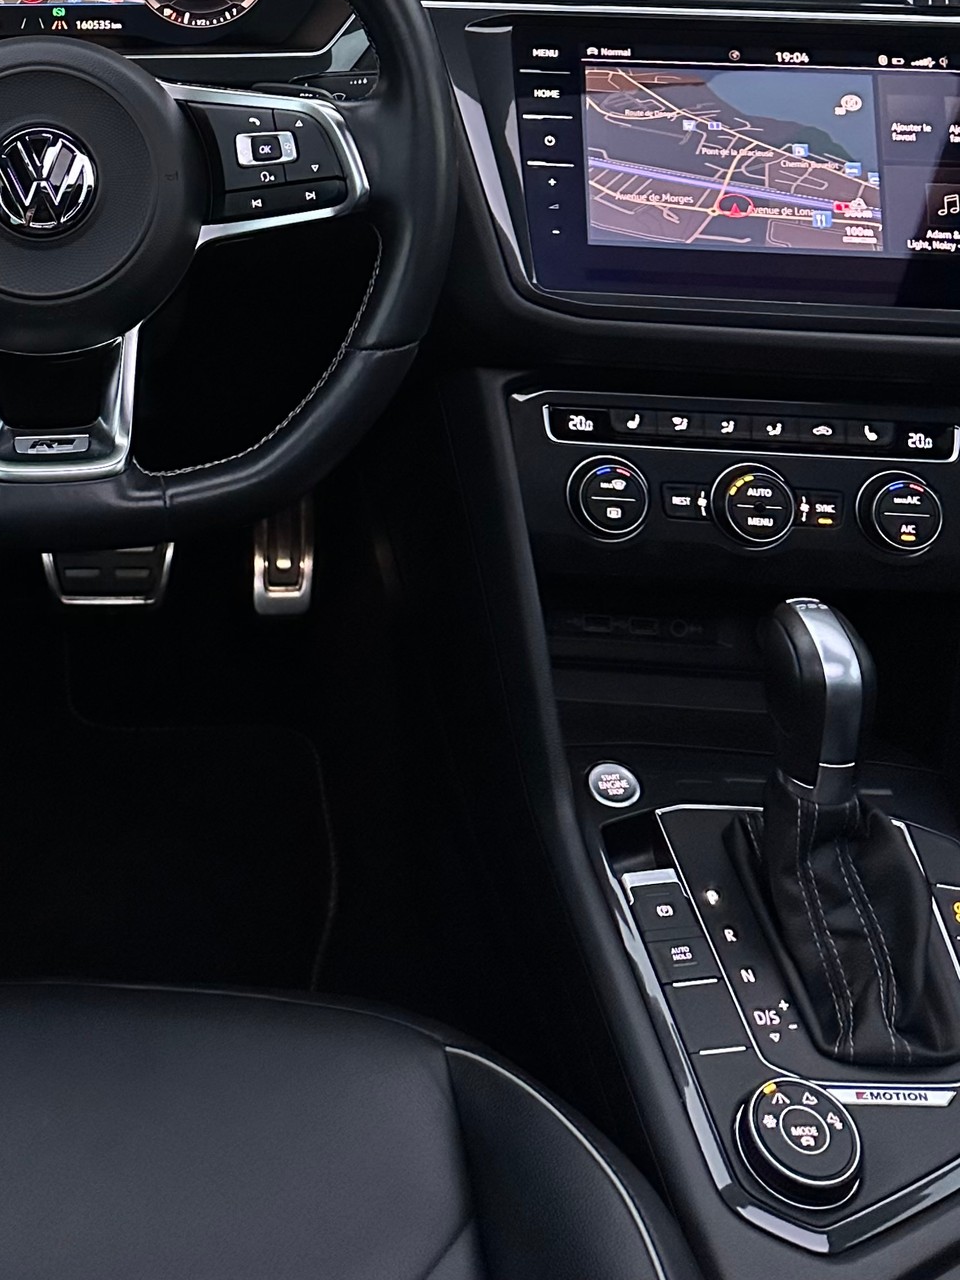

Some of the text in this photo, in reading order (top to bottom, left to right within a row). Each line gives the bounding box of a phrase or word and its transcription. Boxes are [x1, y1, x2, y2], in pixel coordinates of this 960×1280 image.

[76, 21, 110, 30] 160535
[532, 48, 559, 58] MENU
[600, 47, 632, 57] Normal
[775, 51, 810, 63] 19:04
[533, 89, 560, 99] HOME
[624, 109, 644, 117] Route
[891, 123, 932, 133] Ajouter le
[891, 132, 916, 142] favori
[259, 145, 272, 154] OK
[701, 147, 720, 156] Pont
[780, 159, 809, 169] Chemin
[615, 192, 694, 205] Avenue de Morges
[780, 207, 792, 215] de
[844, 226, 874, 236] 100m
[926, 229, 952, 239] Adam
[906, 239, 932, 251] Light,
[746, 487, 772, 498] AUTO
[671, 496, 691, 505] REST
[815, 503, 836, 513] SYNC
[747, 517, 773, 527] MENU
[900, 524, 916, 533] A/C
[601, 773, 620, 781] START
[598, 779, 630, 790] ENGINE
[705, 889, 719, 905] P
[724, 928, 737, 942] R
[670, 945, 690, 954] AUTO
[672, 952, 692, 961] HOLD
[740, 968, 756, 983] N
[753, 1009, 781, 1025] D/S
[855, 1091, 929, 1101] 4MOTION
[790, 1126, 819, 1136] MODE
